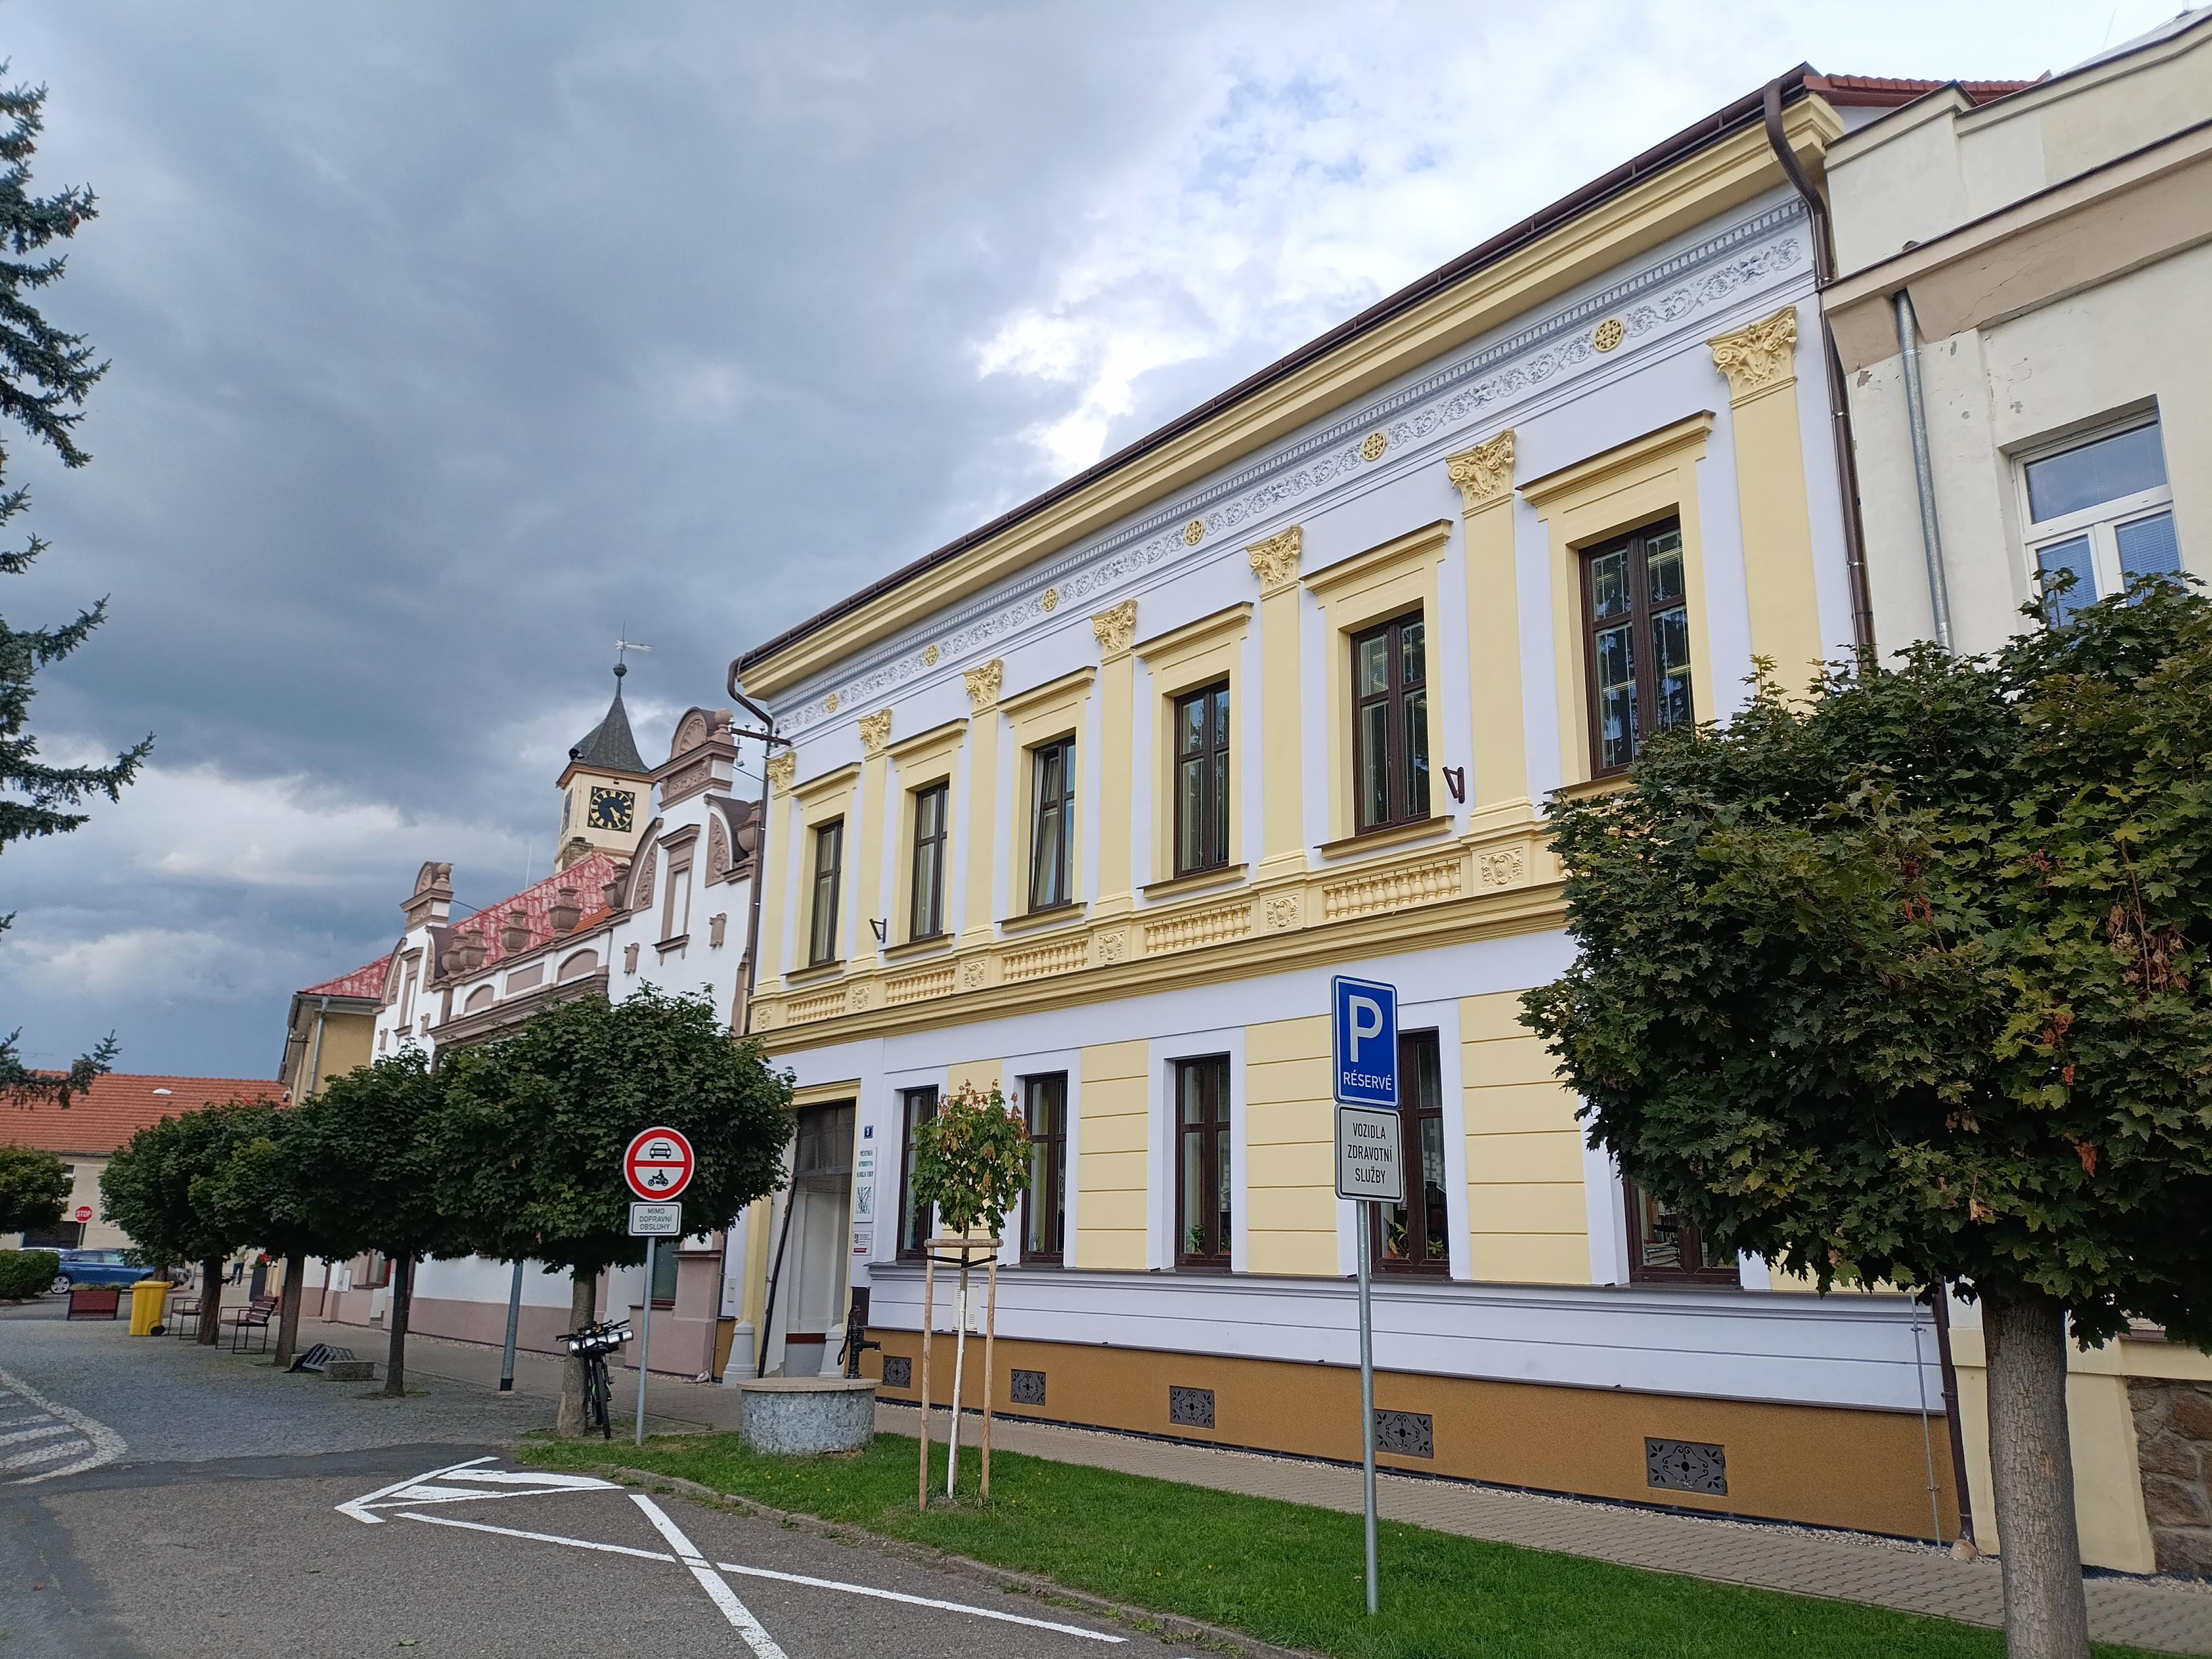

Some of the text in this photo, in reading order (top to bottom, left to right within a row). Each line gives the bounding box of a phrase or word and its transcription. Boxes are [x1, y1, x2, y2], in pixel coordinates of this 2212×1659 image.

[1349, 994, 1383, 1063] P
[1343, 1069, 1392, 1090] RÉSERVÉ
[1353, 1122, 1387, 1140] VOZIDLA
[1347, 1144, 1393, 1162] ZDRAVOTNÍ
[1355, 1166, 1386, 1184] SLUŽBY
